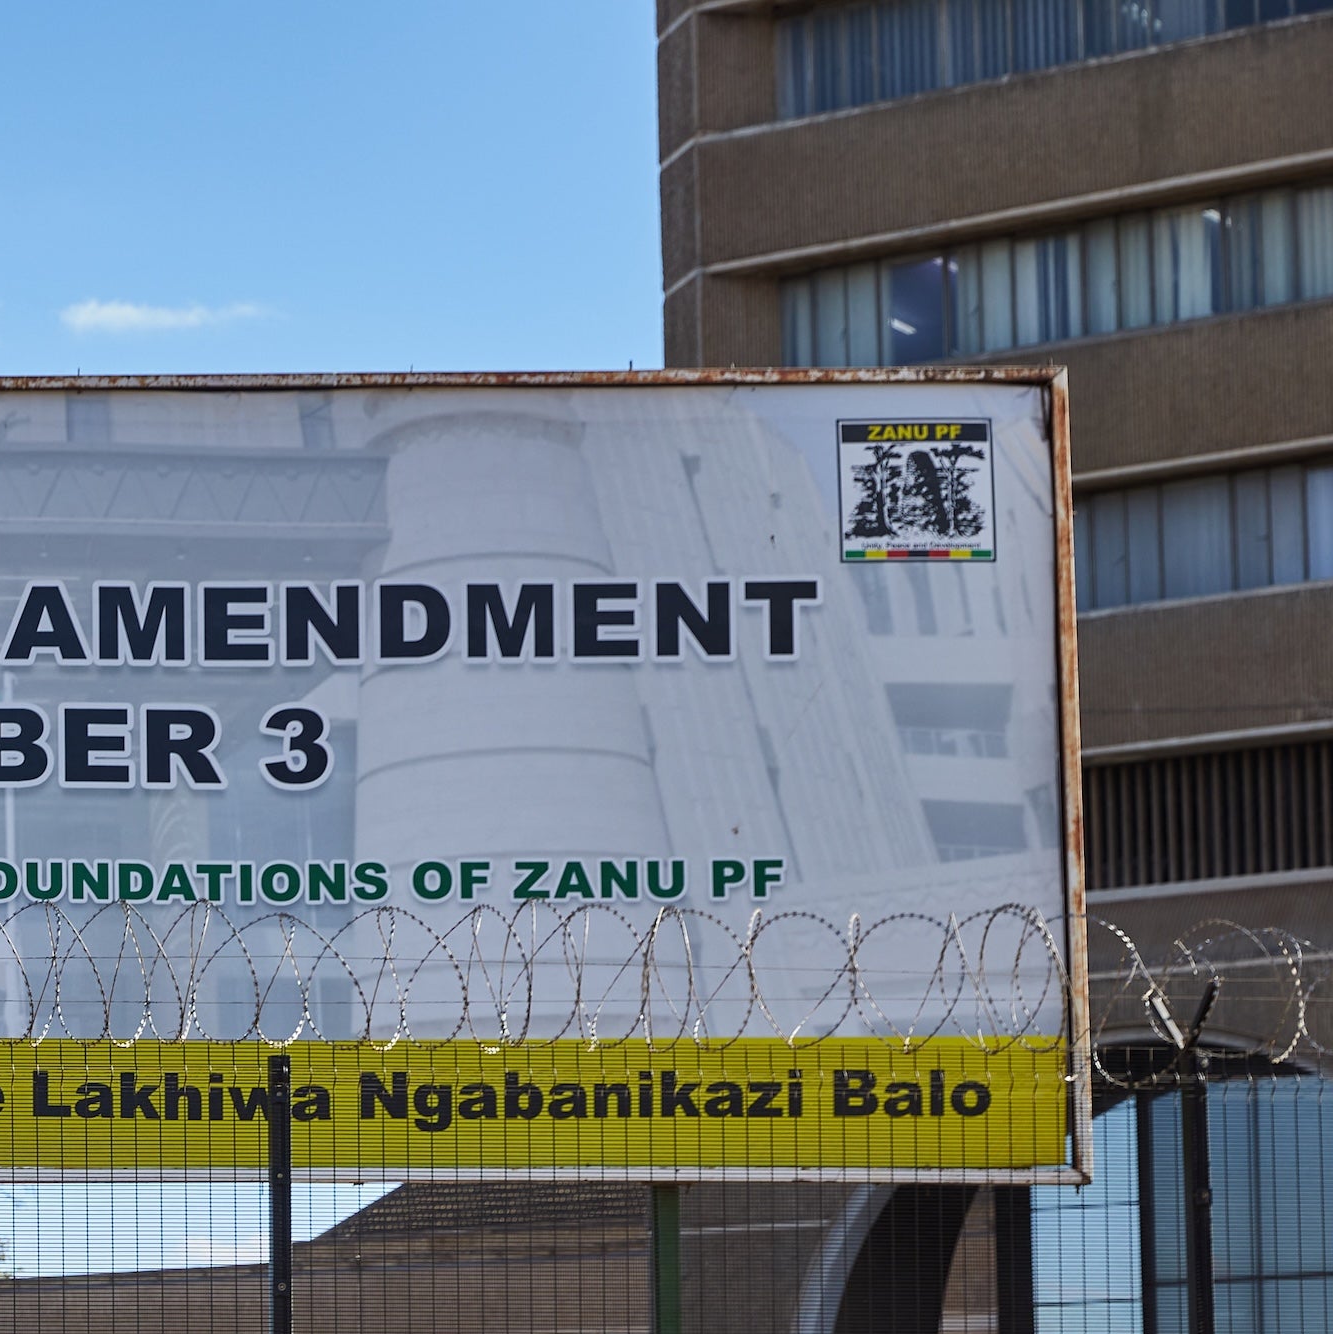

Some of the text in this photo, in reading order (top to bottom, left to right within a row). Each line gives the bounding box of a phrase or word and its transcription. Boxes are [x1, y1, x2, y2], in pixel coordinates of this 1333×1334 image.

[867, 424, 962, 441] ZANU PF
[4, 580, 818, 661] AMENDMENT
[265, 707, 329, 785] 3
[411, 860, 491, 900] OF
[512, 859, 685, 900] ZANU
[711, 858, 784, 899] PF
[32, 1069, 332, 1121] Lakhiwa
[359, 1069, 803, 1132] Ngabanikazi
[832, 1069, 992, 1118] Balo
